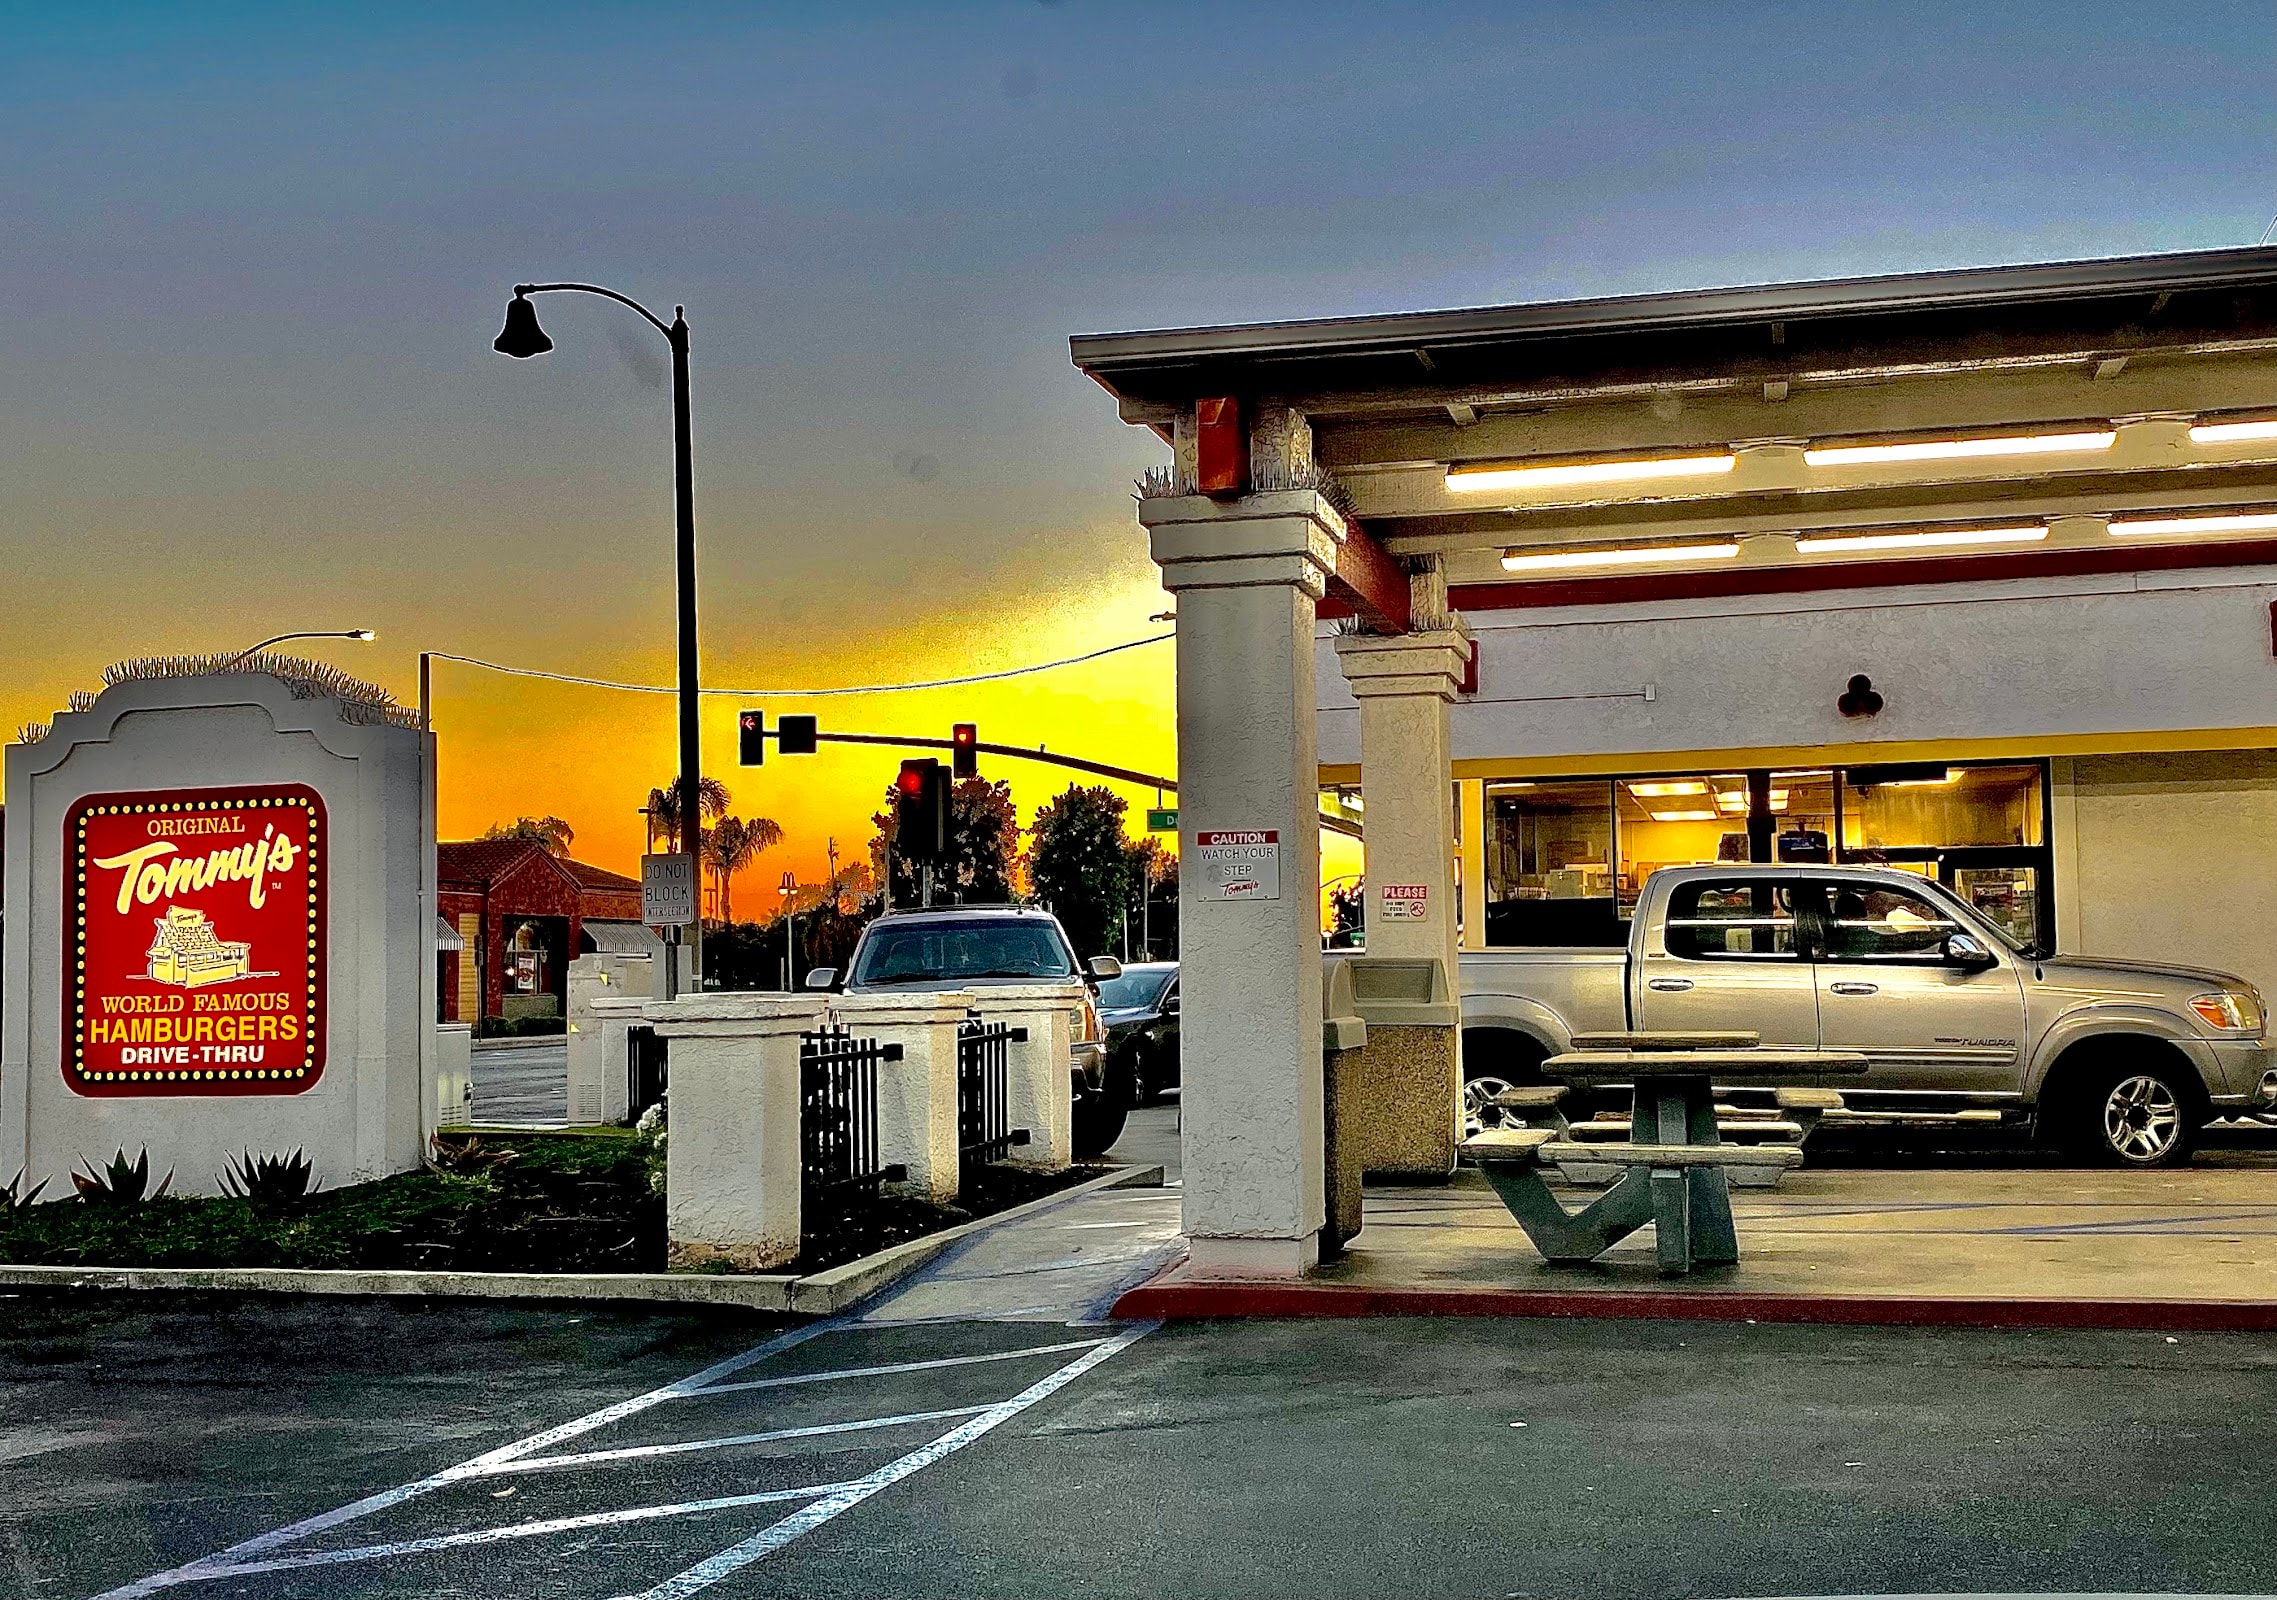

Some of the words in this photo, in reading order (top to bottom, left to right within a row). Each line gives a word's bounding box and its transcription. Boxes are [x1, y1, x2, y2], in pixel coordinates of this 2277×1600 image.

[147, 816, 246, 837] ORIGINAL
[1210, 832, 1267, 845] CAUTION
[1201, 849, 1240, 859] WATCH
[1242, 847, 1275, 858] YOUR
[93, 822, 302, 915] Tommy's
[645, 864, 661, 880] DO
[665, 863, 689, 878] NOT
[1224, 865, 1252, 876] STEP
[645, 886, 689, 902] BLOCK
[1384, 887, 1426, 898] PLEASE
[645, 905, 690, 917] INTERSECTION
[101, 995, 185, 1014] WORLD
[192, 992, 290, 1012] FAMOUS
[90, 1015, 299, 1044] HAMBURGERS
[1960, 1038, 2016, 1047] TUNDRA
[121, 1045, 265, 1064] DRIVE-THRU
